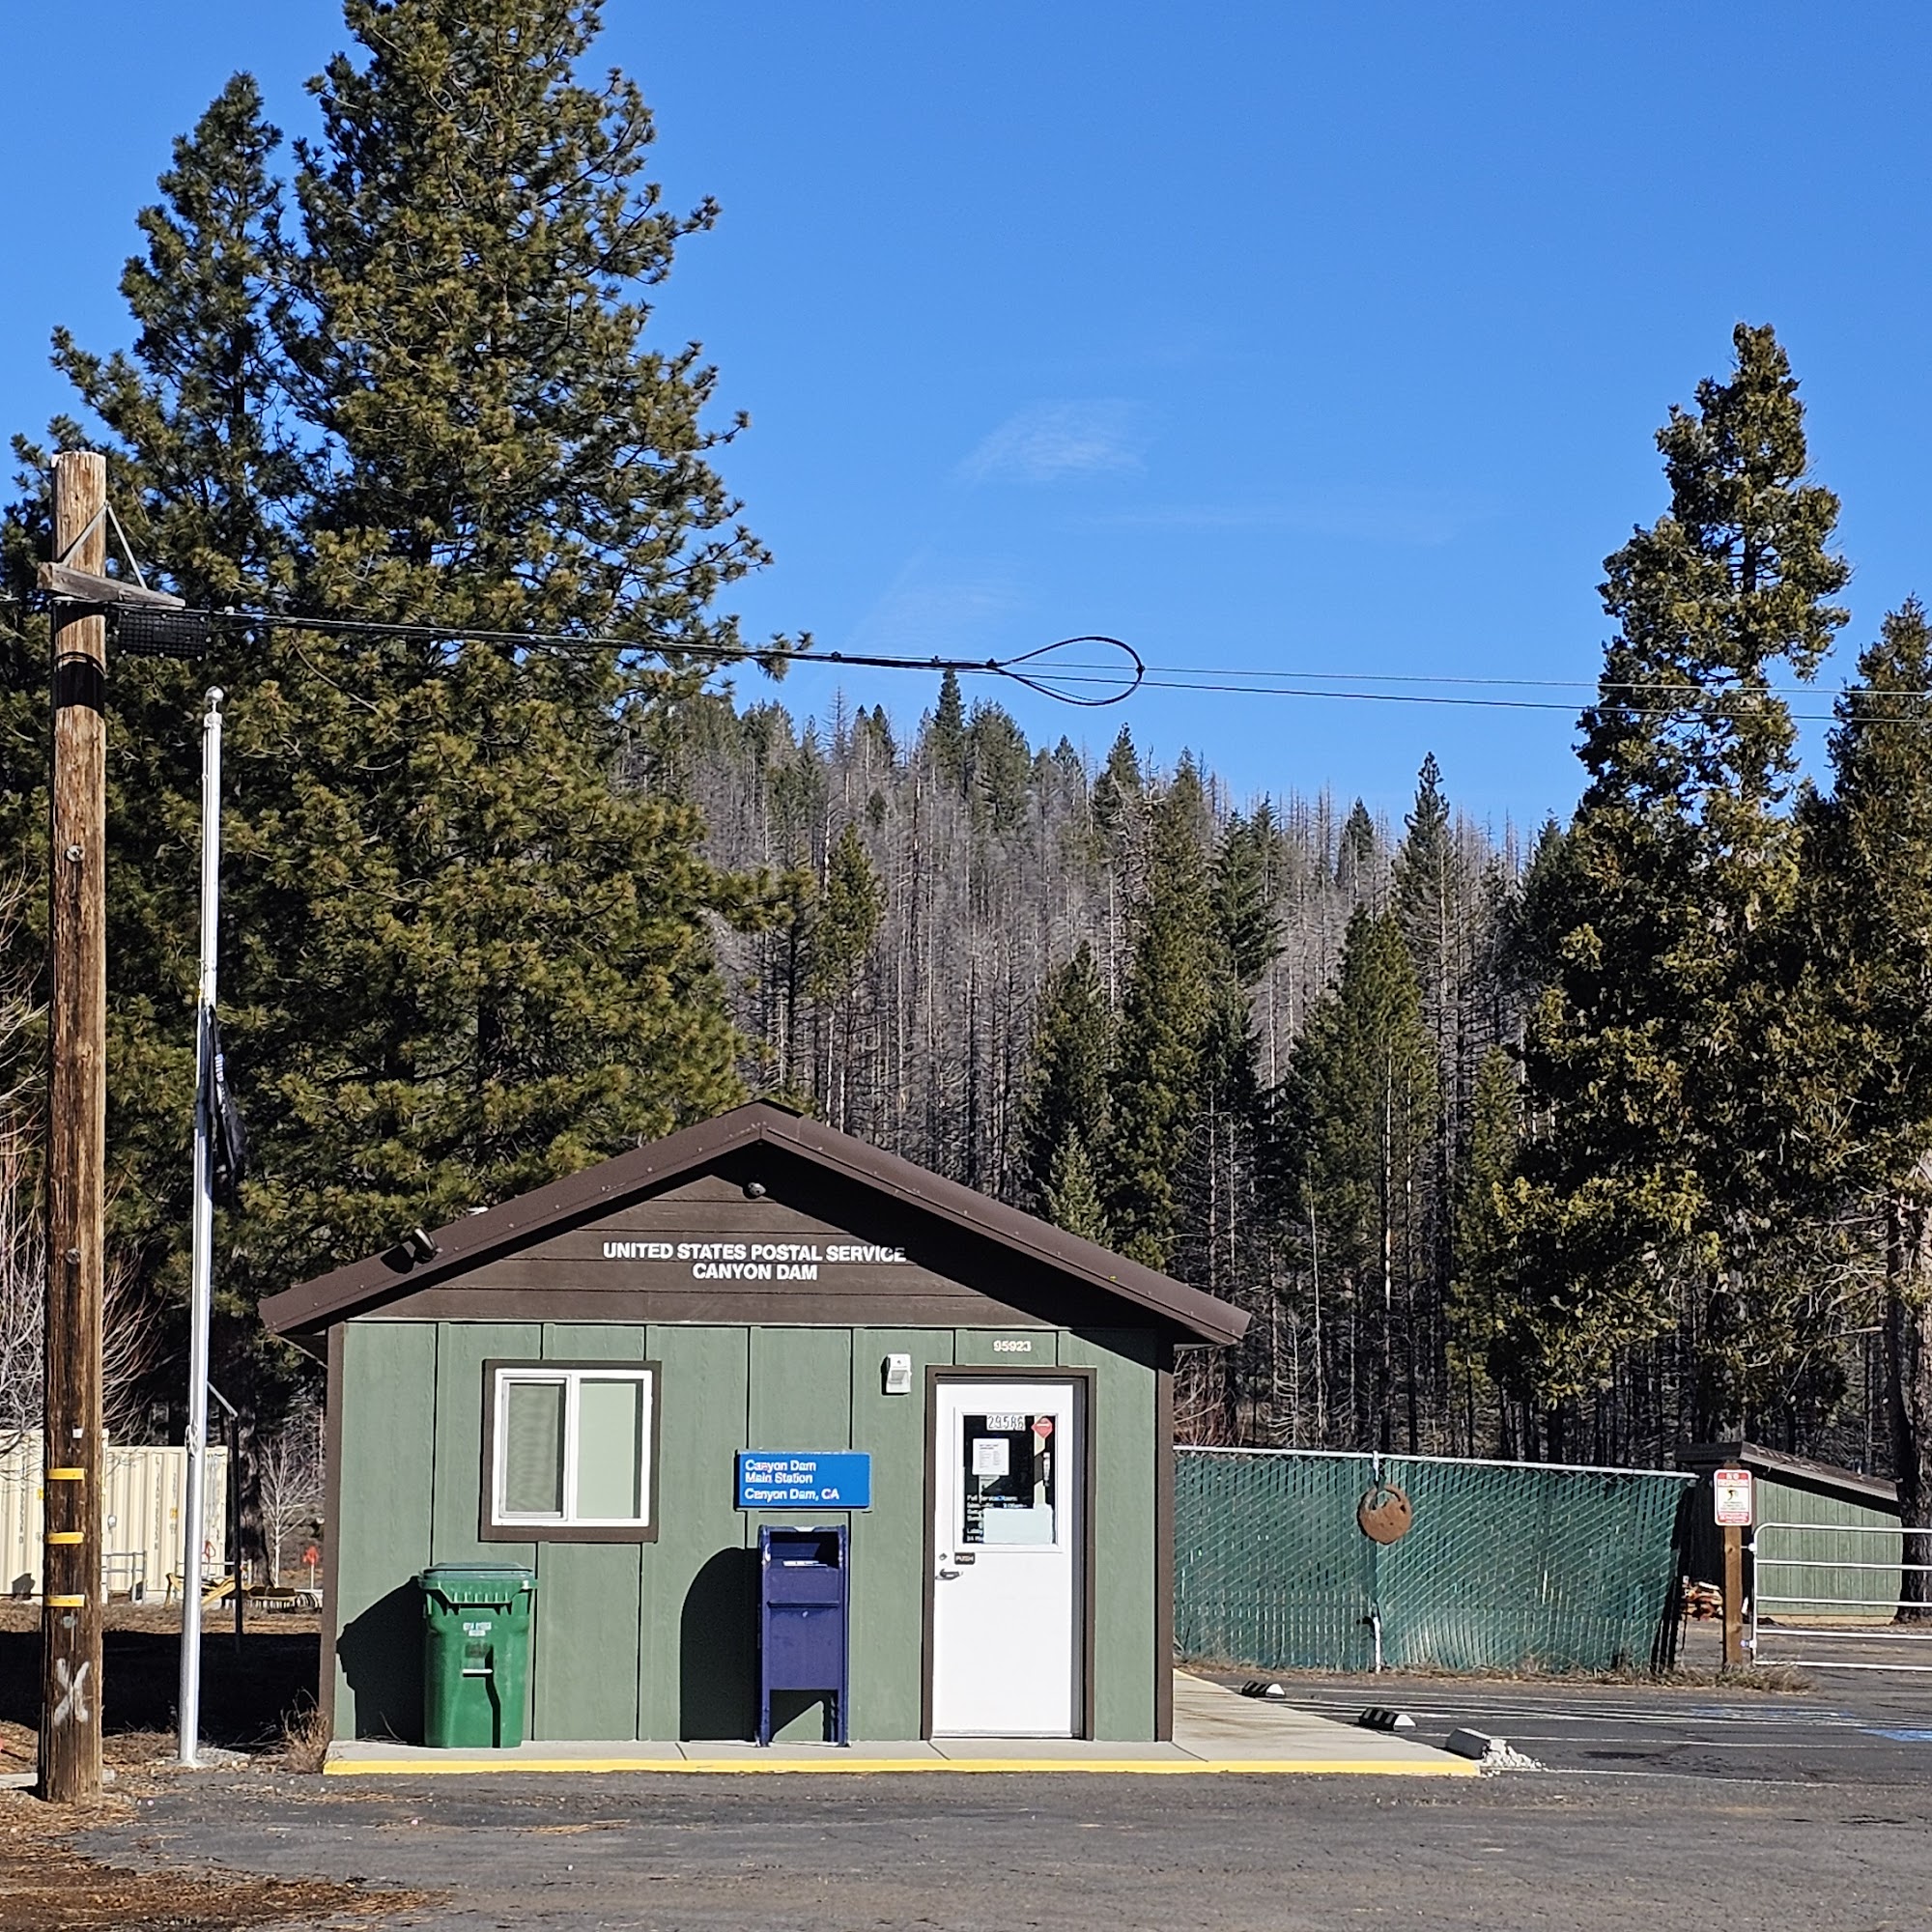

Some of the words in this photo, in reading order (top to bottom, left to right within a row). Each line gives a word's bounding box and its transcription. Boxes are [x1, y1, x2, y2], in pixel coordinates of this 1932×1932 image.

[603, 1242, 673, 1259] UNITED
[677, 1243, 747, 1260] STATES
[751, 1244, 823, 1262] POSTAL
[826, 1245, 907, 1263] SERVICE
[693, 1263, 771, 1280] CANYON
[777, 1264, 818, 1281] DAM
[993, 1340, 1032, 1352] 95923
[745, 1460, 787, 1473] Canyon
[790, 1460, 816, 1471] Dam
[745, 1472, 772, 1484] Main
[775, 1472, 813, 1484] Station
[745, 1488, 787, 1502] Canyon
[789, 1489, 819, 1501] Dam,
[821, 1489, 840, 1500] CA
